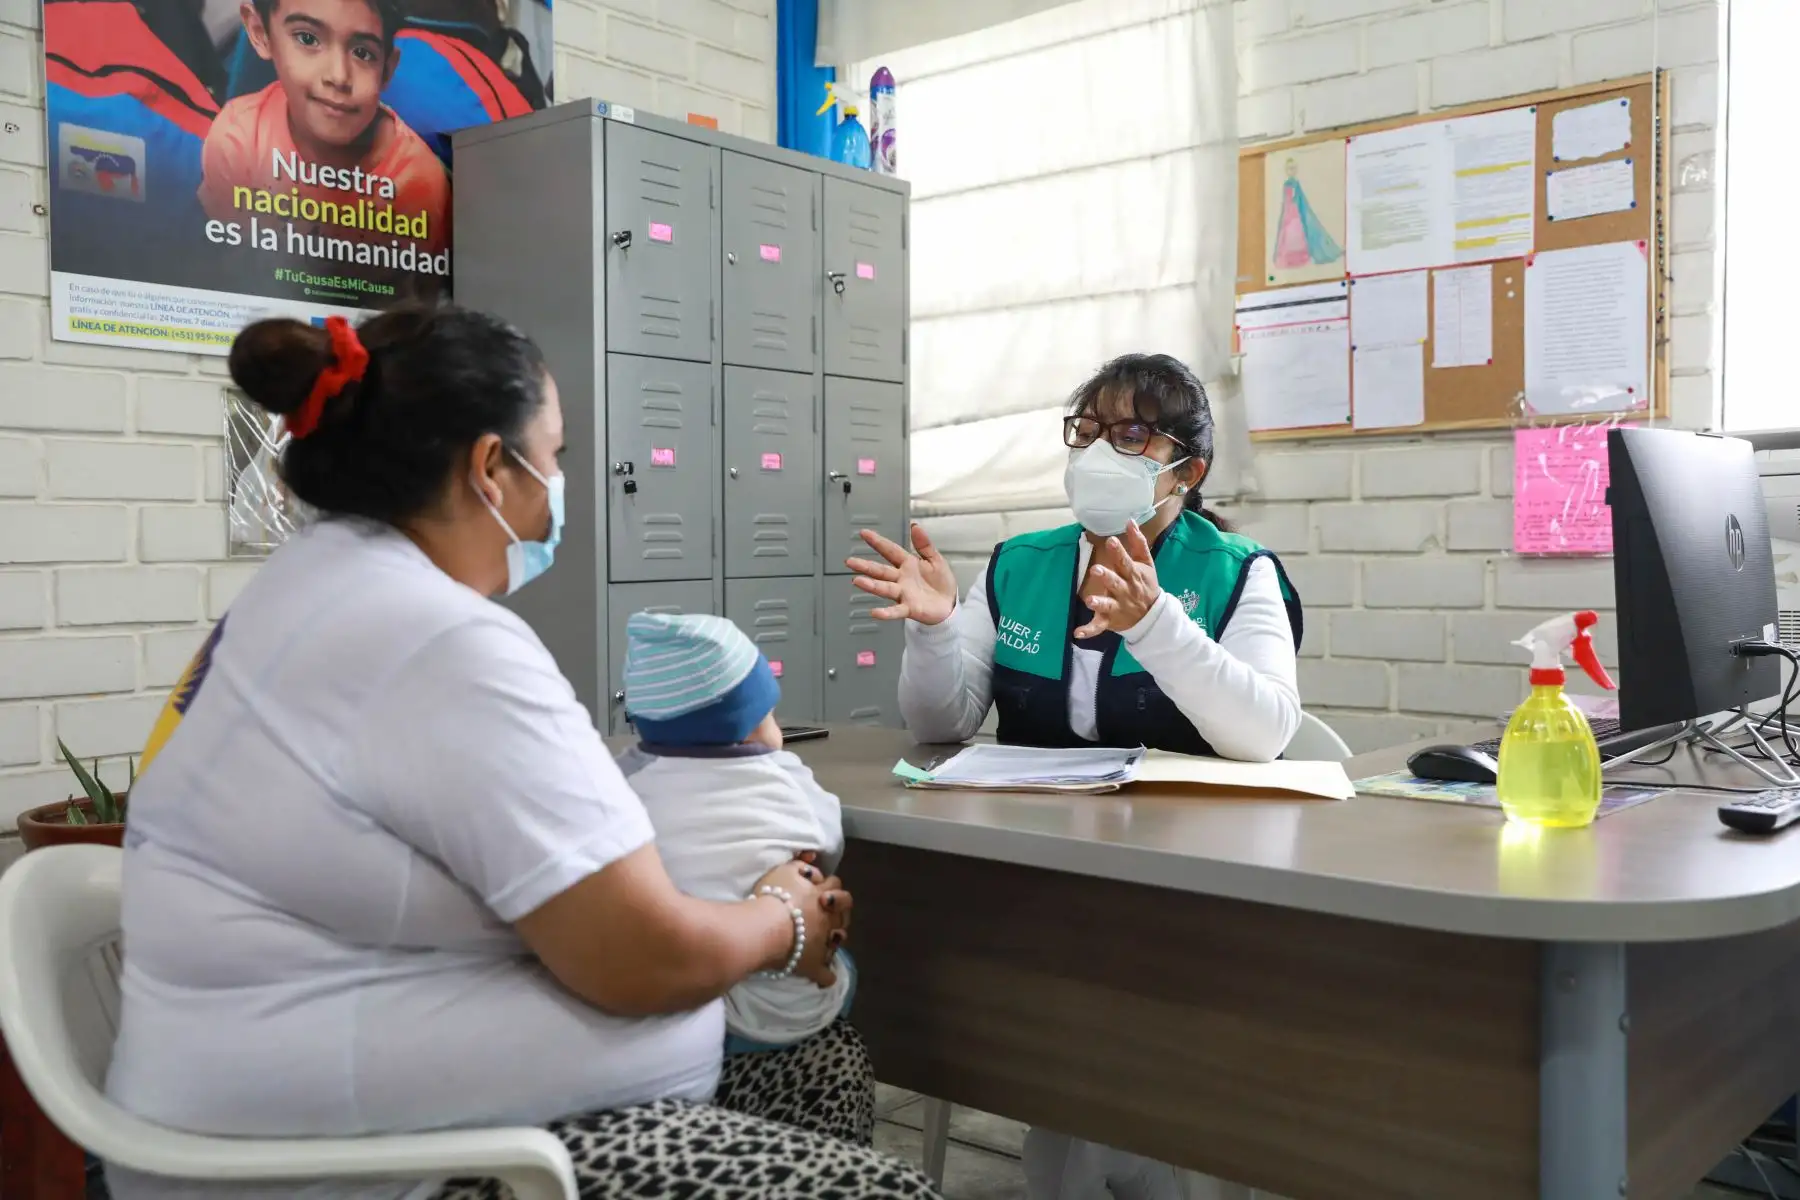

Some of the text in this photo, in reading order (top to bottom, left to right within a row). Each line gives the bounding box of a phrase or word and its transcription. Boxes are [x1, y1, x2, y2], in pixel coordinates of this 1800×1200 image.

[272, 148, 395, 200] Nuestra
[233, 185, 428, 240] nacionalidad
[205, 217, 450, 276] es la humanidad
[274, 267, 395, 296] #TuCausaEsMiCausa
[103, 322, 116, 332] DE
[159, 314, 169, 322] 24
[1728, 514, 1742, 570] hp
[999, 615, 1031, 639] UJER
[996, 630, 1040, 654] ALDAD
